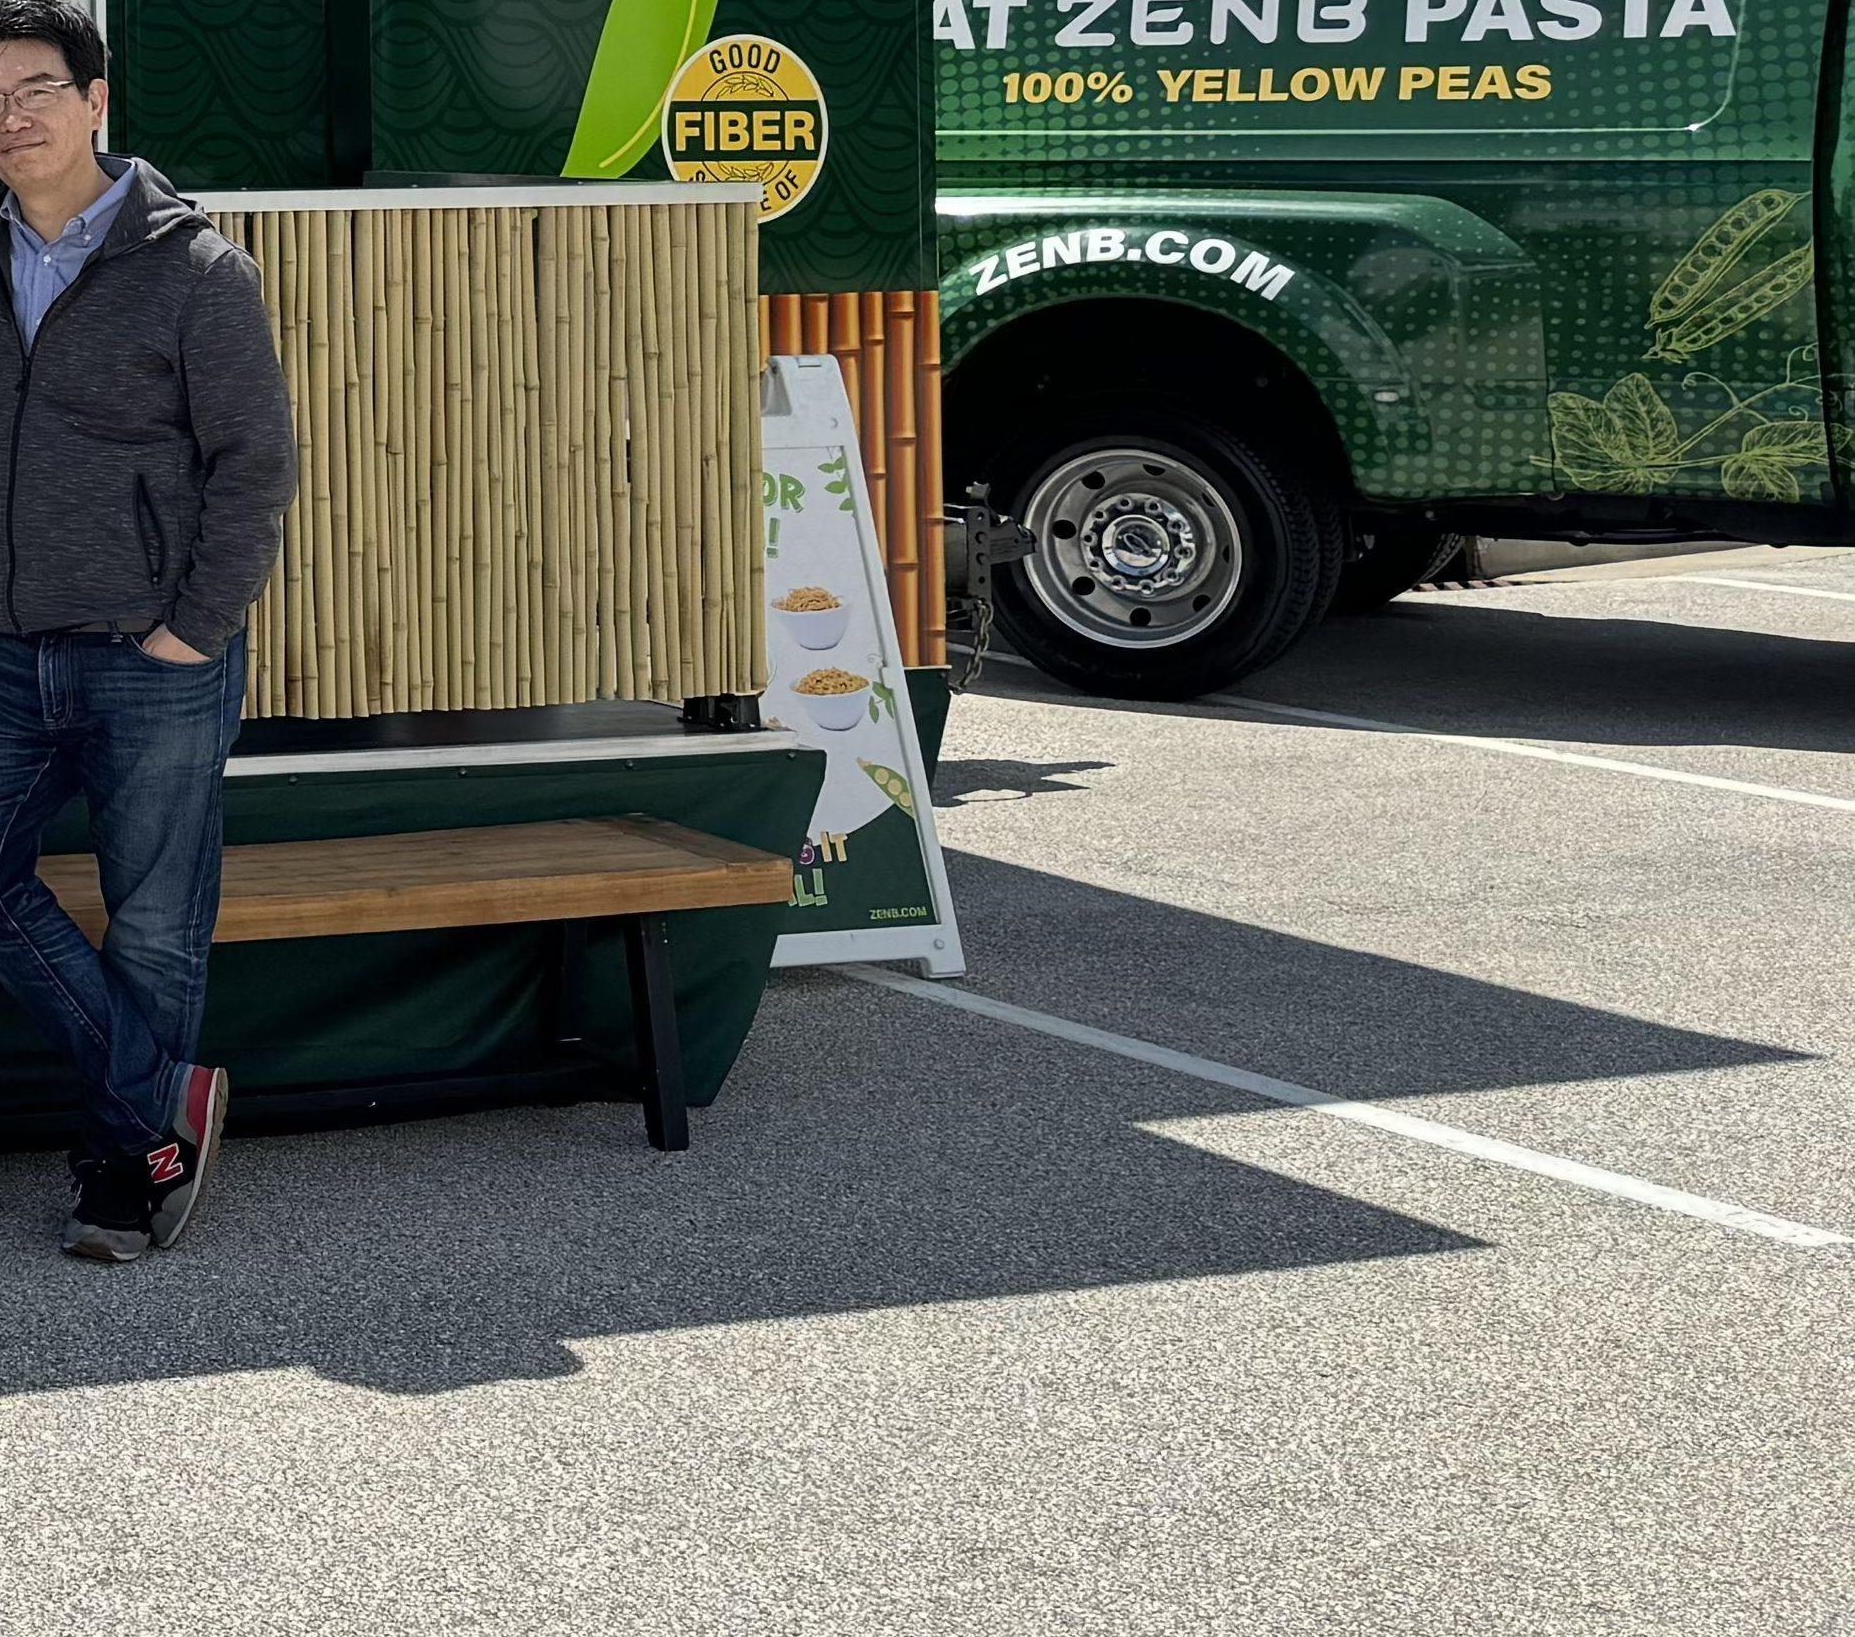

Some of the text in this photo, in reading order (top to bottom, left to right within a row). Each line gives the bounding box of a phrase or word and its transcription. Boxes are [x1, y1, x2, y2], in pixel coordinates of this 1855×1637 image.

[709, 43, 781, 75] GOOD
[1003, 65, 1552, 103] 100% YELLOW PEAS
[675, 111, 815, 151] FIBER
[775, 169, 802, 201] OF
[968, 228, 1295, 301] ZENB.COM
[820, 831, 848, 863] IT
[869, 906, 927, 920] ZENB.COM
